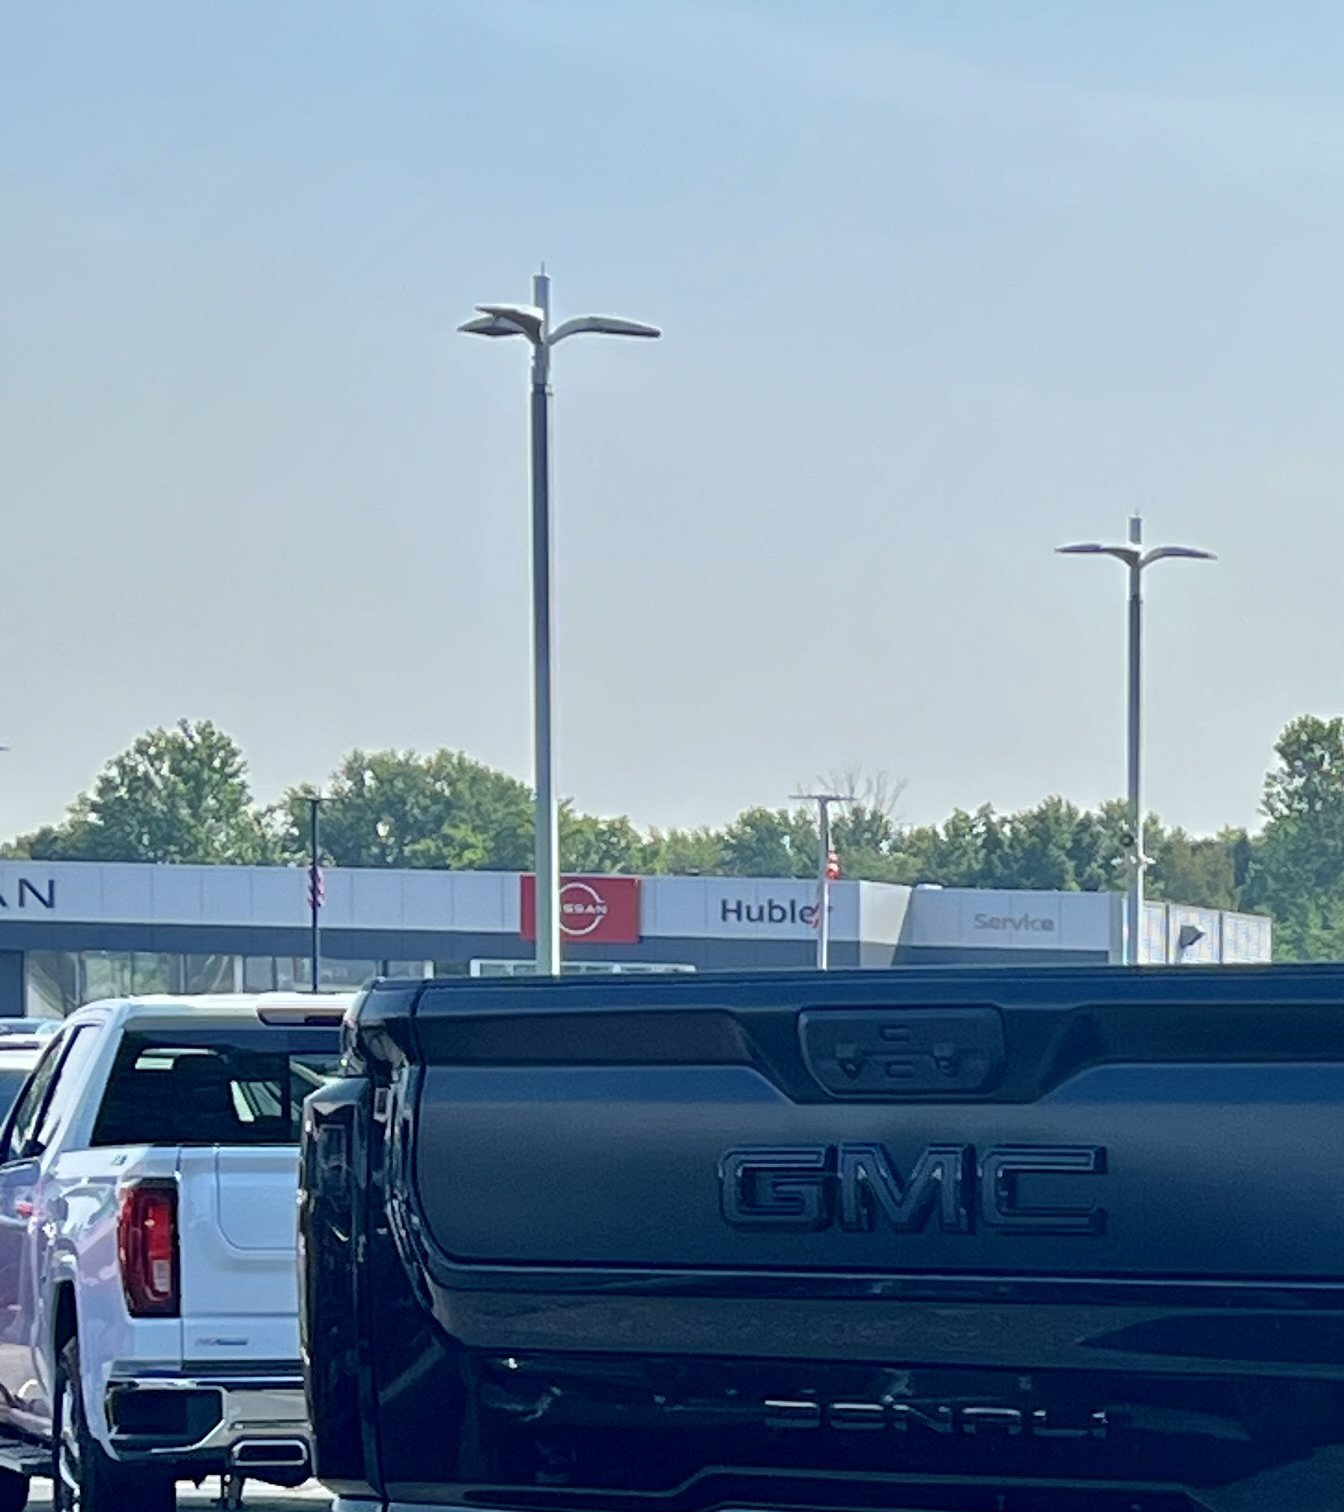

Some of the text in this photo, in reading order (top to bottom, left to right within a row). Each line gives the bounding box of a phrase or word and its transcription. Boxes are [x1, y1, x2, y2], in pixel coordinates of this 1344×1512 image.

[974, 912, 1056, 932] Service
[718, 1142, 1109, 1237] GMC
[763, 1398, 1107, 1438] DENALI
